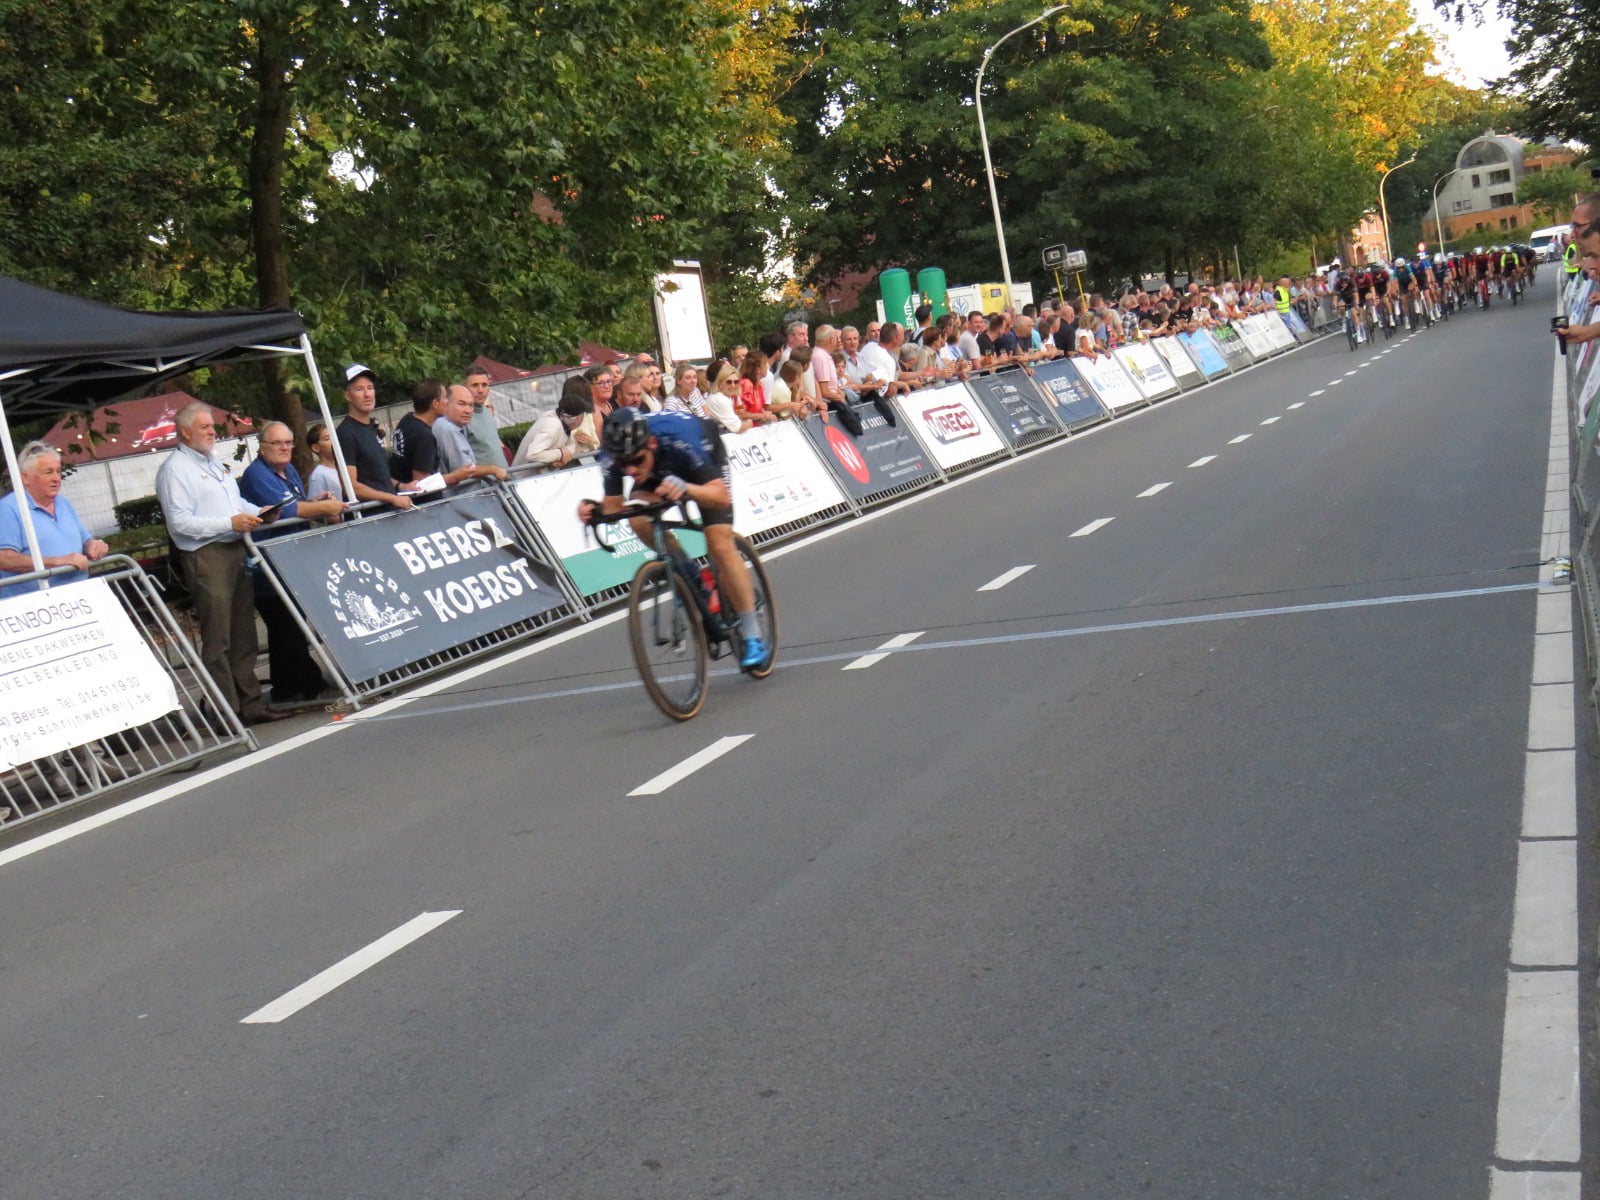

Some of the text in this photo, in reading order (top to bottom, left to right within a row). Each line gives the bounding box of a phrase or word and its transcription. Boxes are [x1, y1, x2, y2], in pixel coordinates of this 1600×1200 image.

[326, 558, 423, 639] BEERSE KOERST
[423, 557, 538, 623] KOERST
[35, 629, 105, 657] DAKWERKEN
[0, 650, 119, 693] VELBEKLEDING
[11, 706, 50, 724] Beerse
